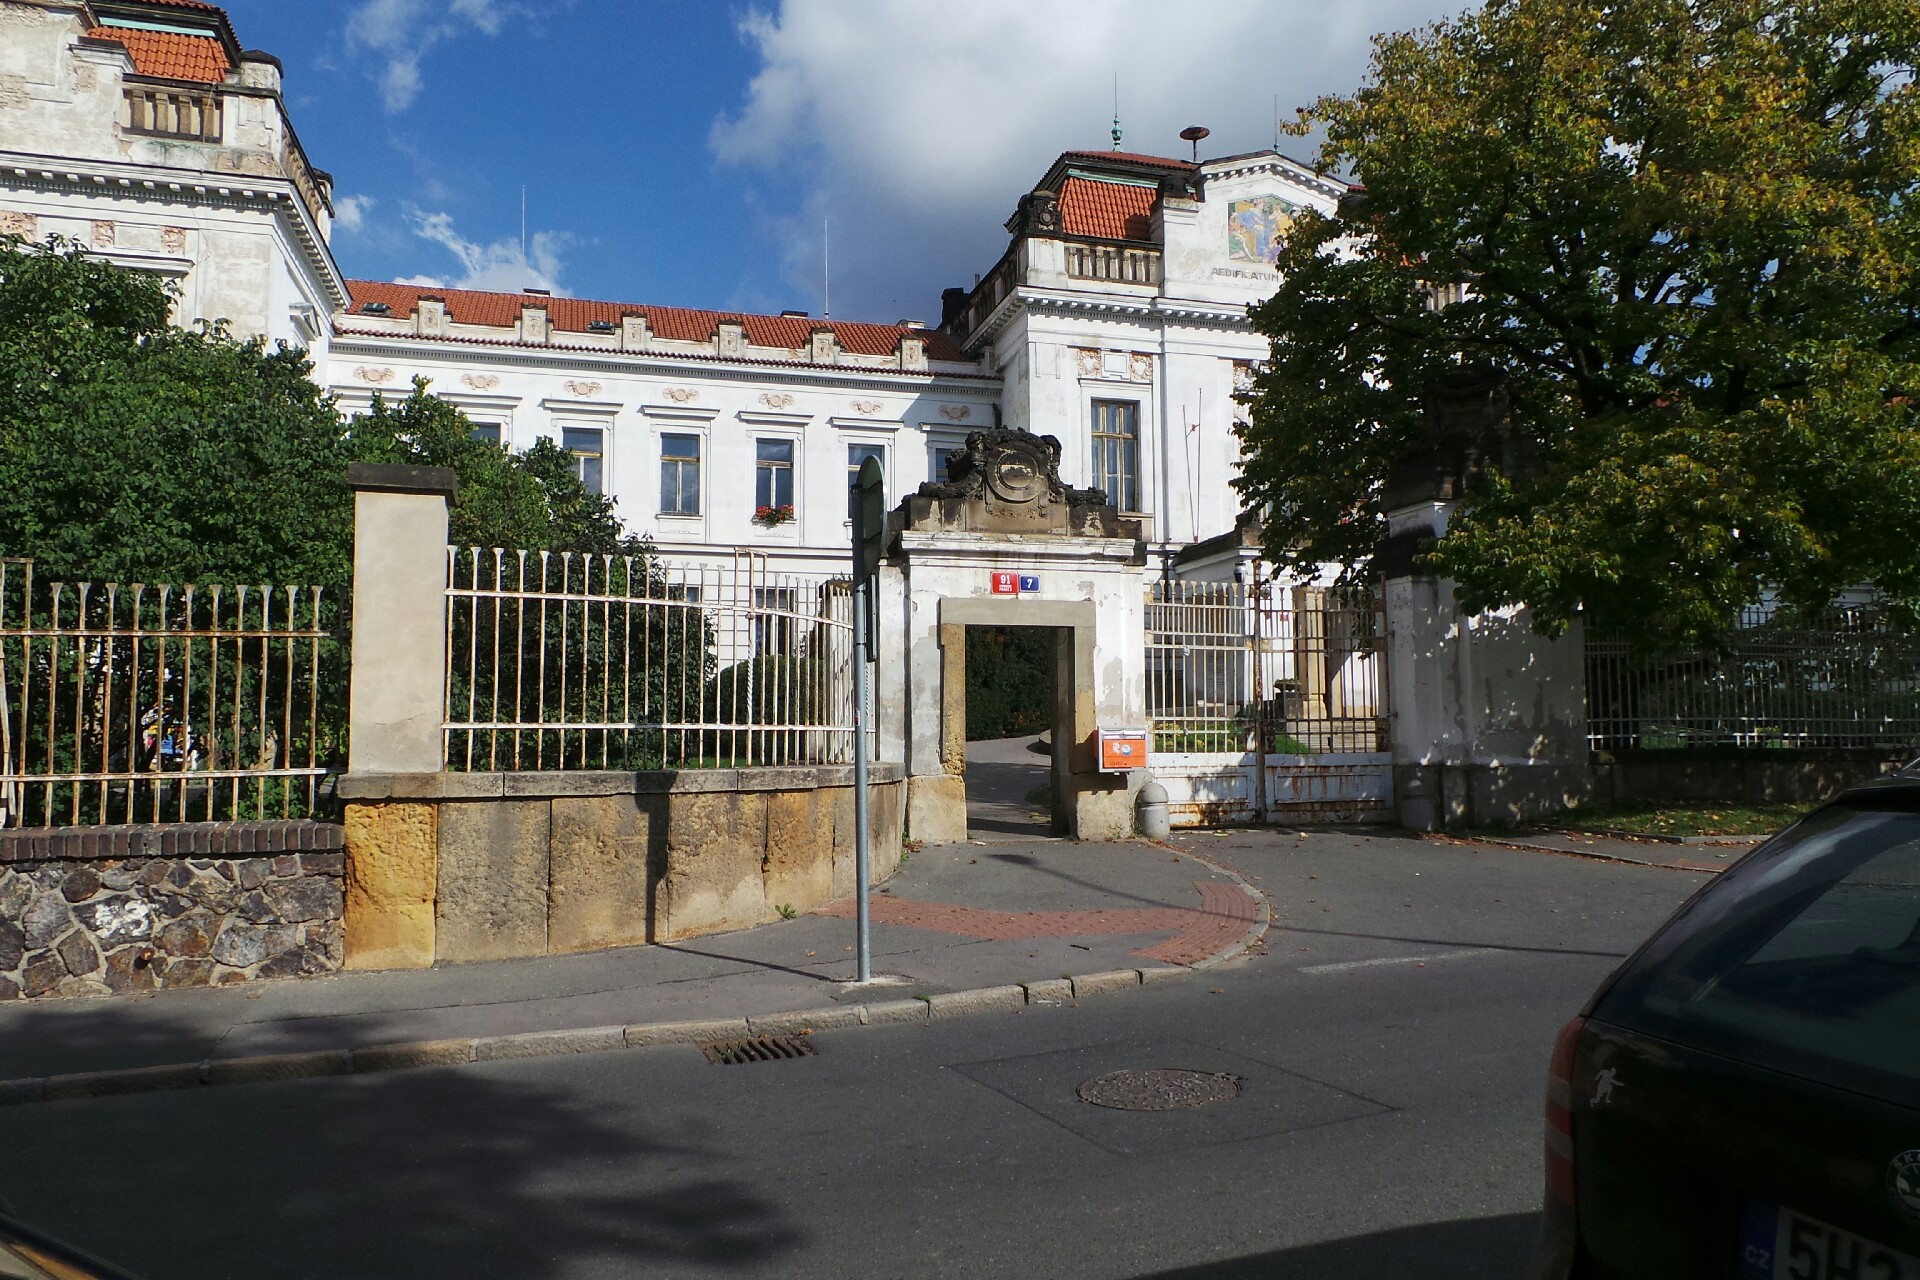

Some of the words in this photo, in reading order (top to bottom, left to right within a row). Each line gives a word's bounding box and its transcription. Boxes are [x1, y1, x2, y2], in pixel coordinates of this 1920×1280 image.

[1211, 267, 1279, 282] AEDIFICATUM
[1000, 574, 1011, 584] 91
[1027, 579, 1033, 588] 7
[1744, 1244, 1771, 1270] CZ
